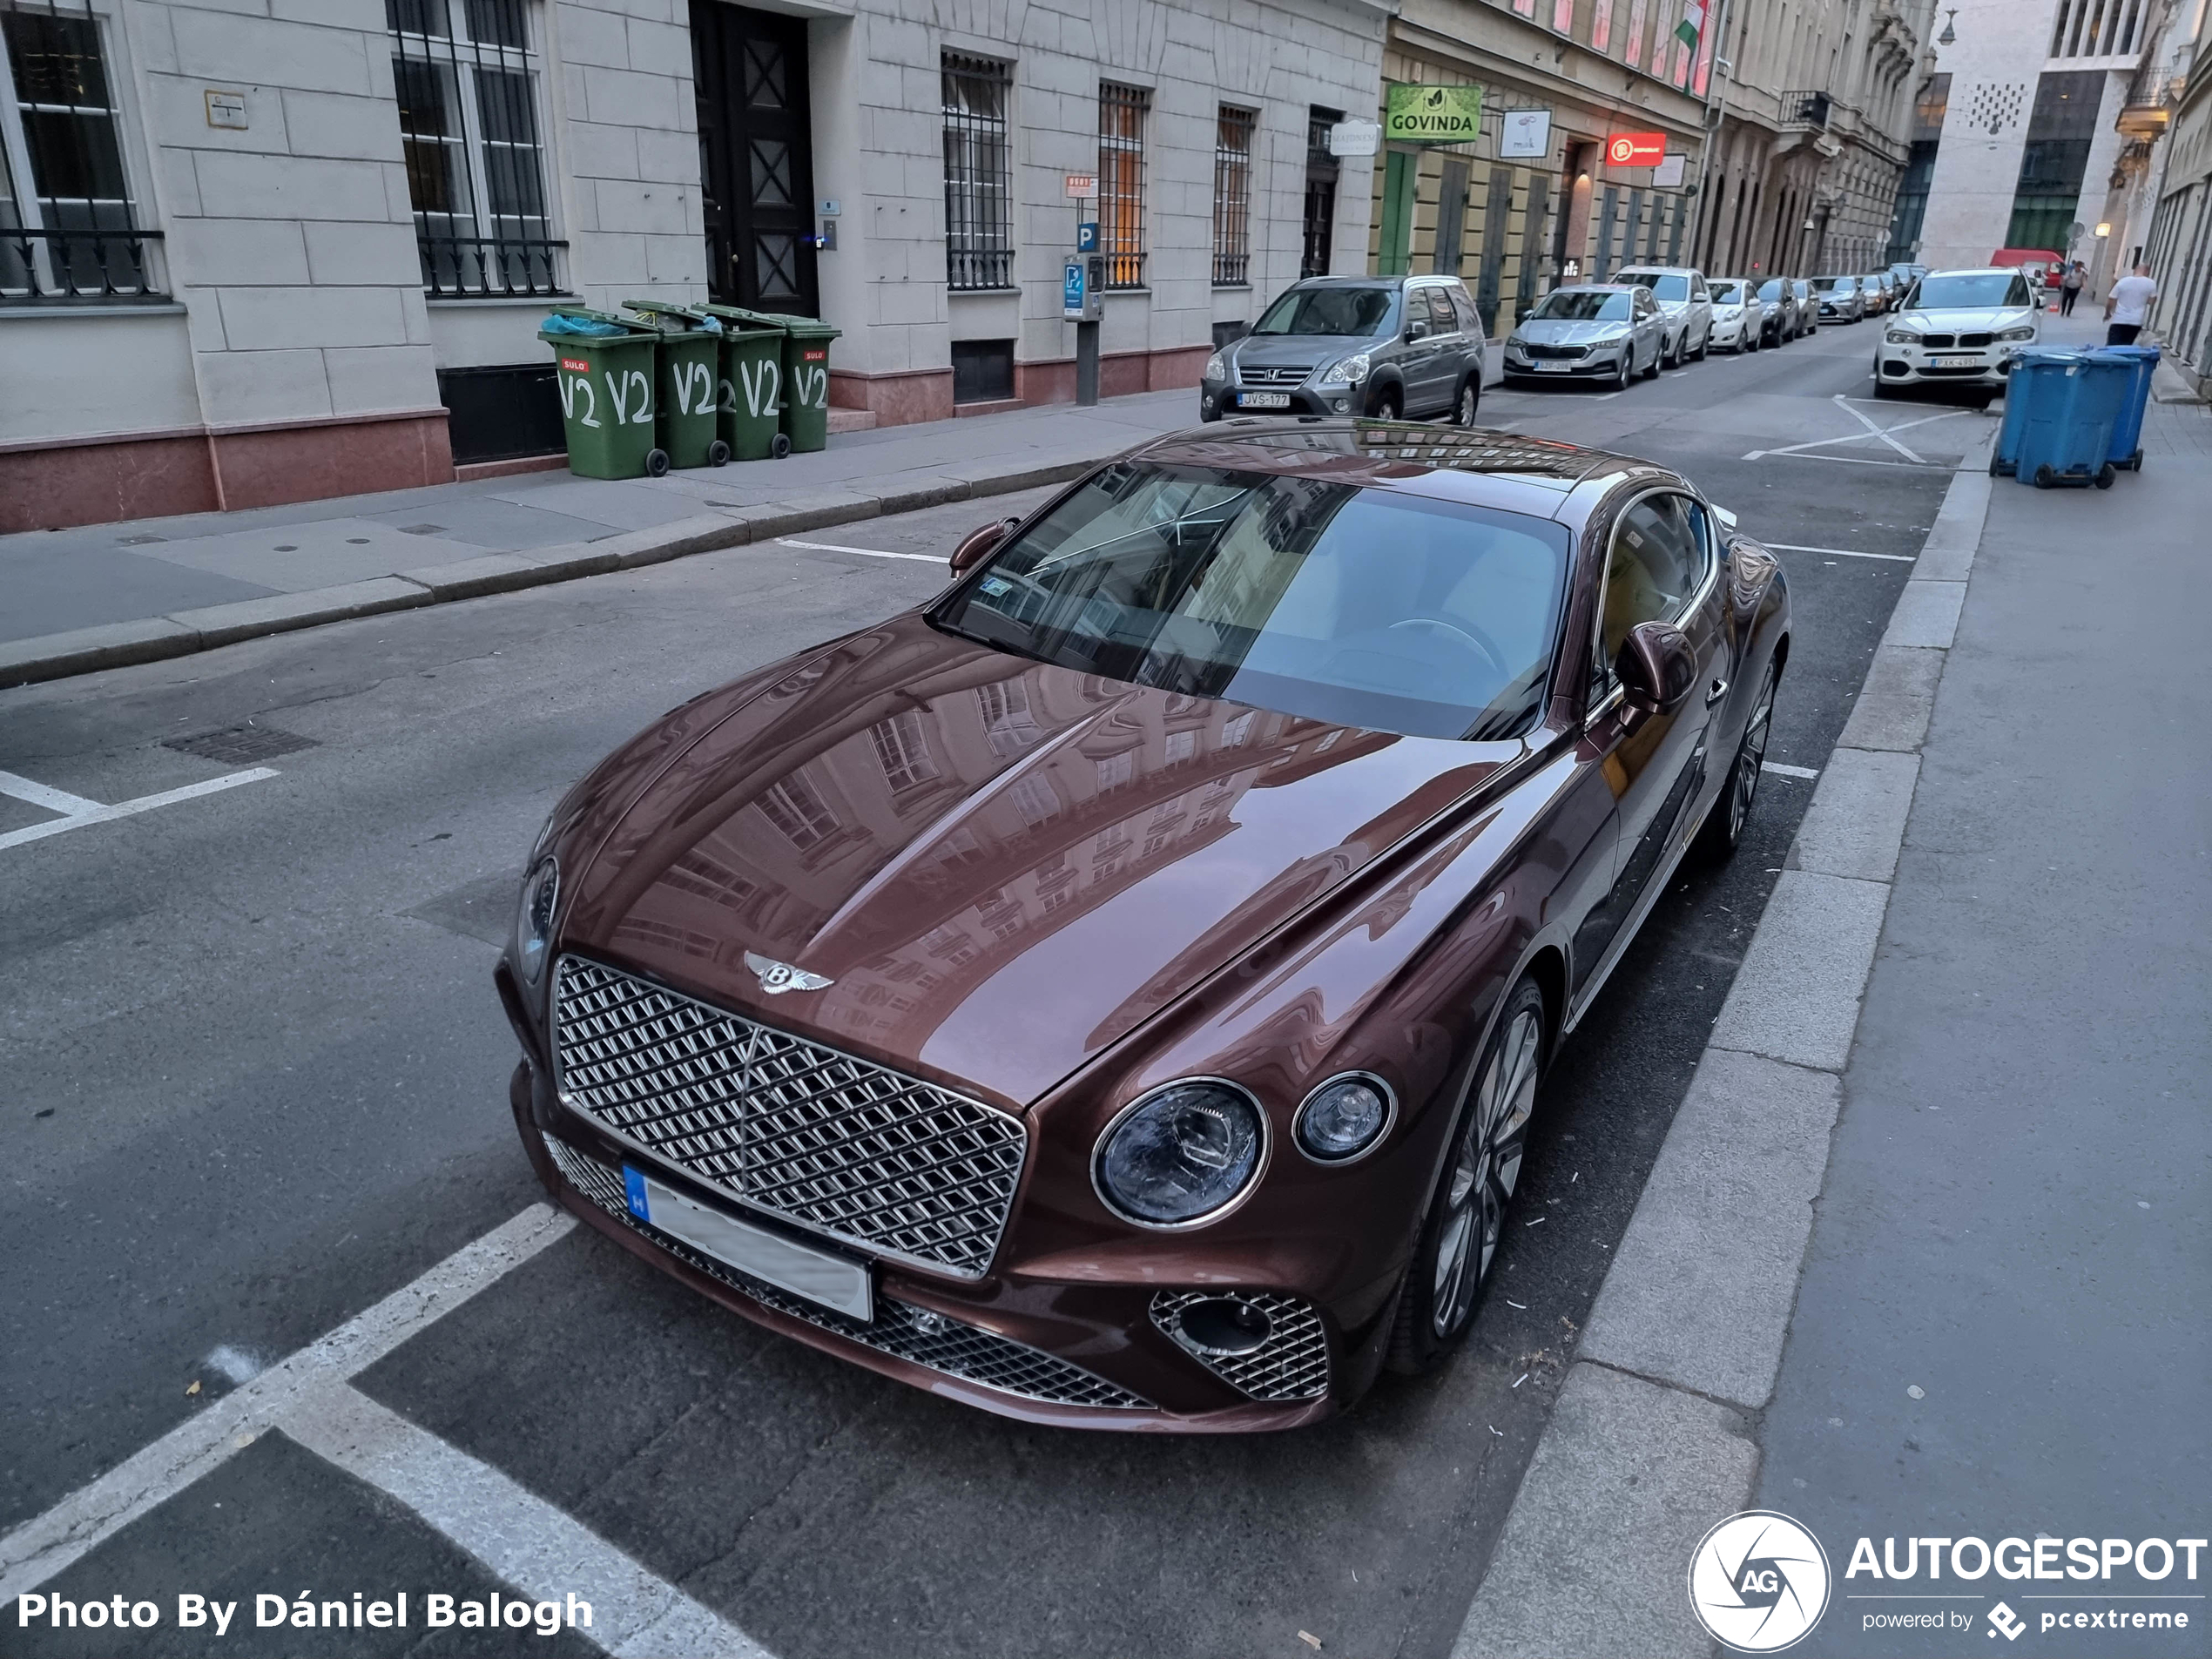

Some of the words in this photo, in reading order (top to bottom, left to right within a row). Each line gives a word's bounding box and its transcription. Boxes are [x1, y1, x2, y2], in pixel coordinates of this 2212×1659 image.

[1392, 114, 1473, 131] GOVINDA
[1080, 227, 1092, 246] P
[564, 360, 585, 370] SULO
[794, 365, 828, 409] V2
[557, 369, 602, 428] V2
[604, 369, 653, 425] V2
[673, 361, 717, 415] V2
[740, 359, 779, 418] V2
[1244, 395, 1287, 405] JVS-177
